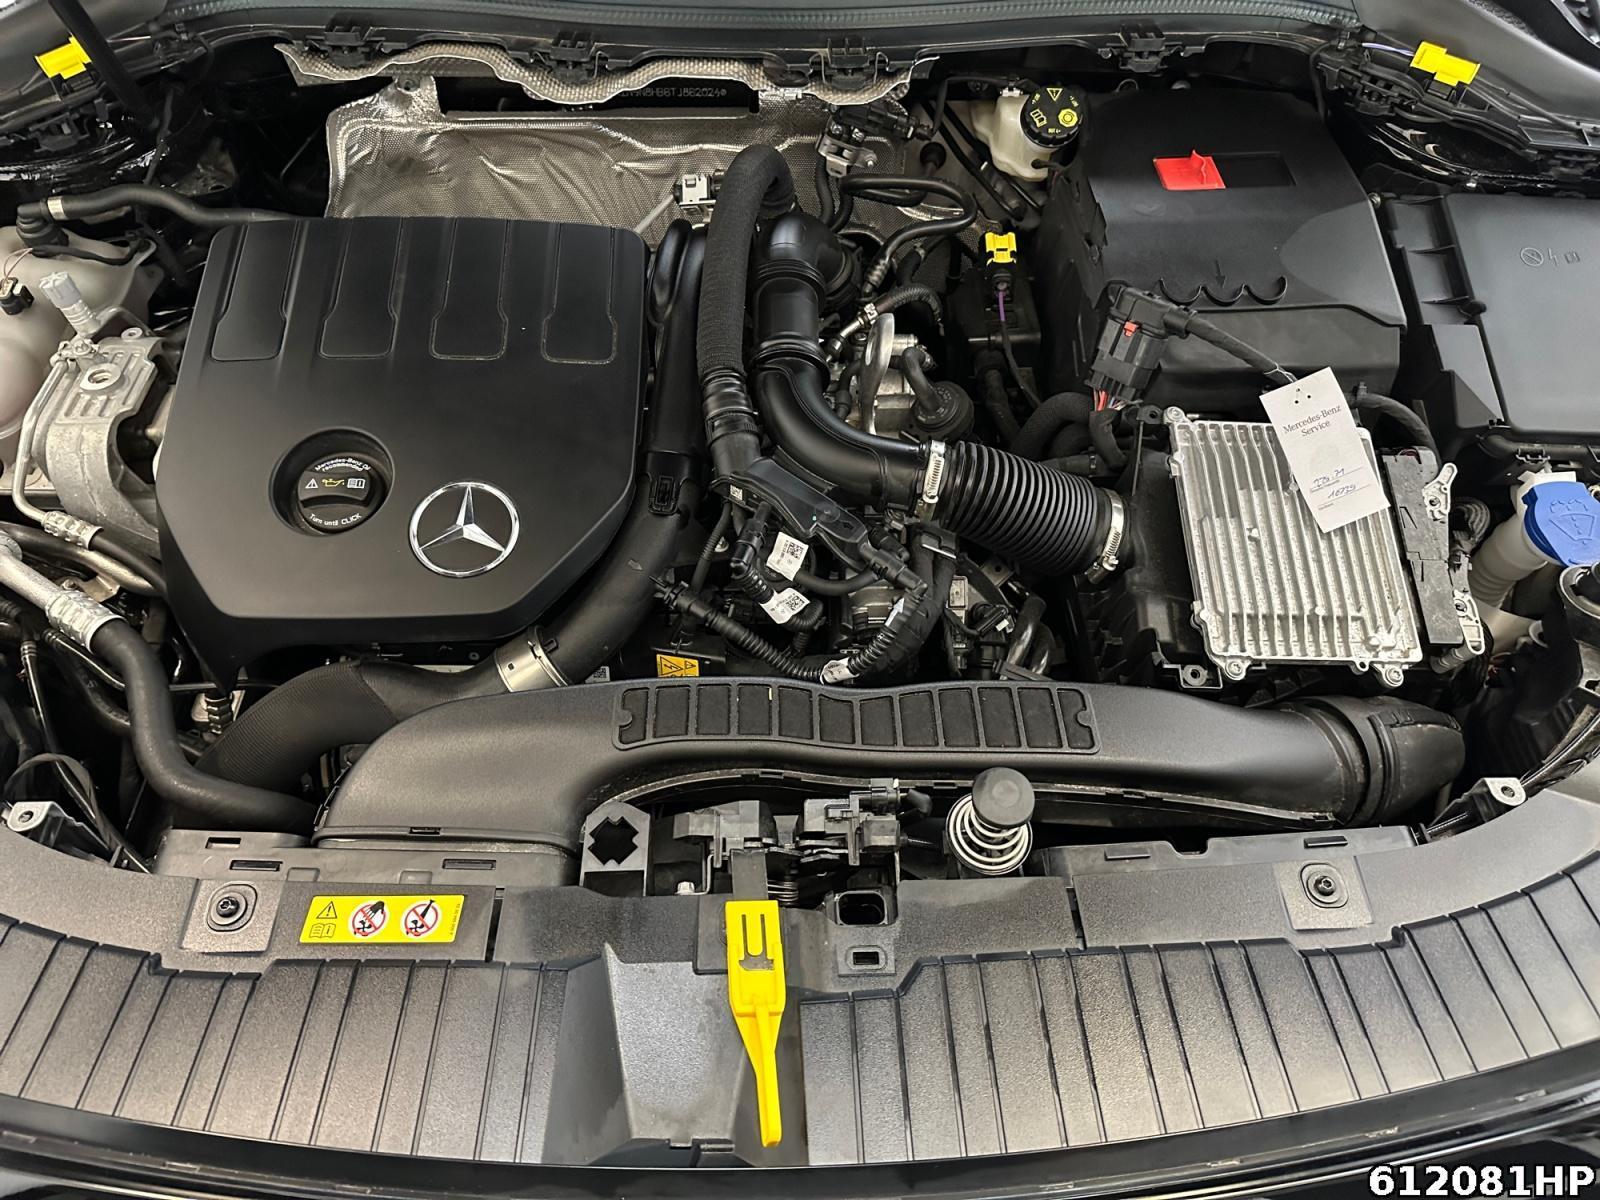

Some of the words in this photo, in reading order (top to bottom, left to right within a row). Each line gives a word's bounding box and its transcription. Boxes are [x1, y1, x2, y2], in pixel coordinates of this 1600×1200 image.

[1283, 404, 1341, 433] Mercedes-Benz
[1301, 420, 1330, 437] Service
[309, 513, 322, 524] Turn
[340, 512, 362, 525] CLICK
